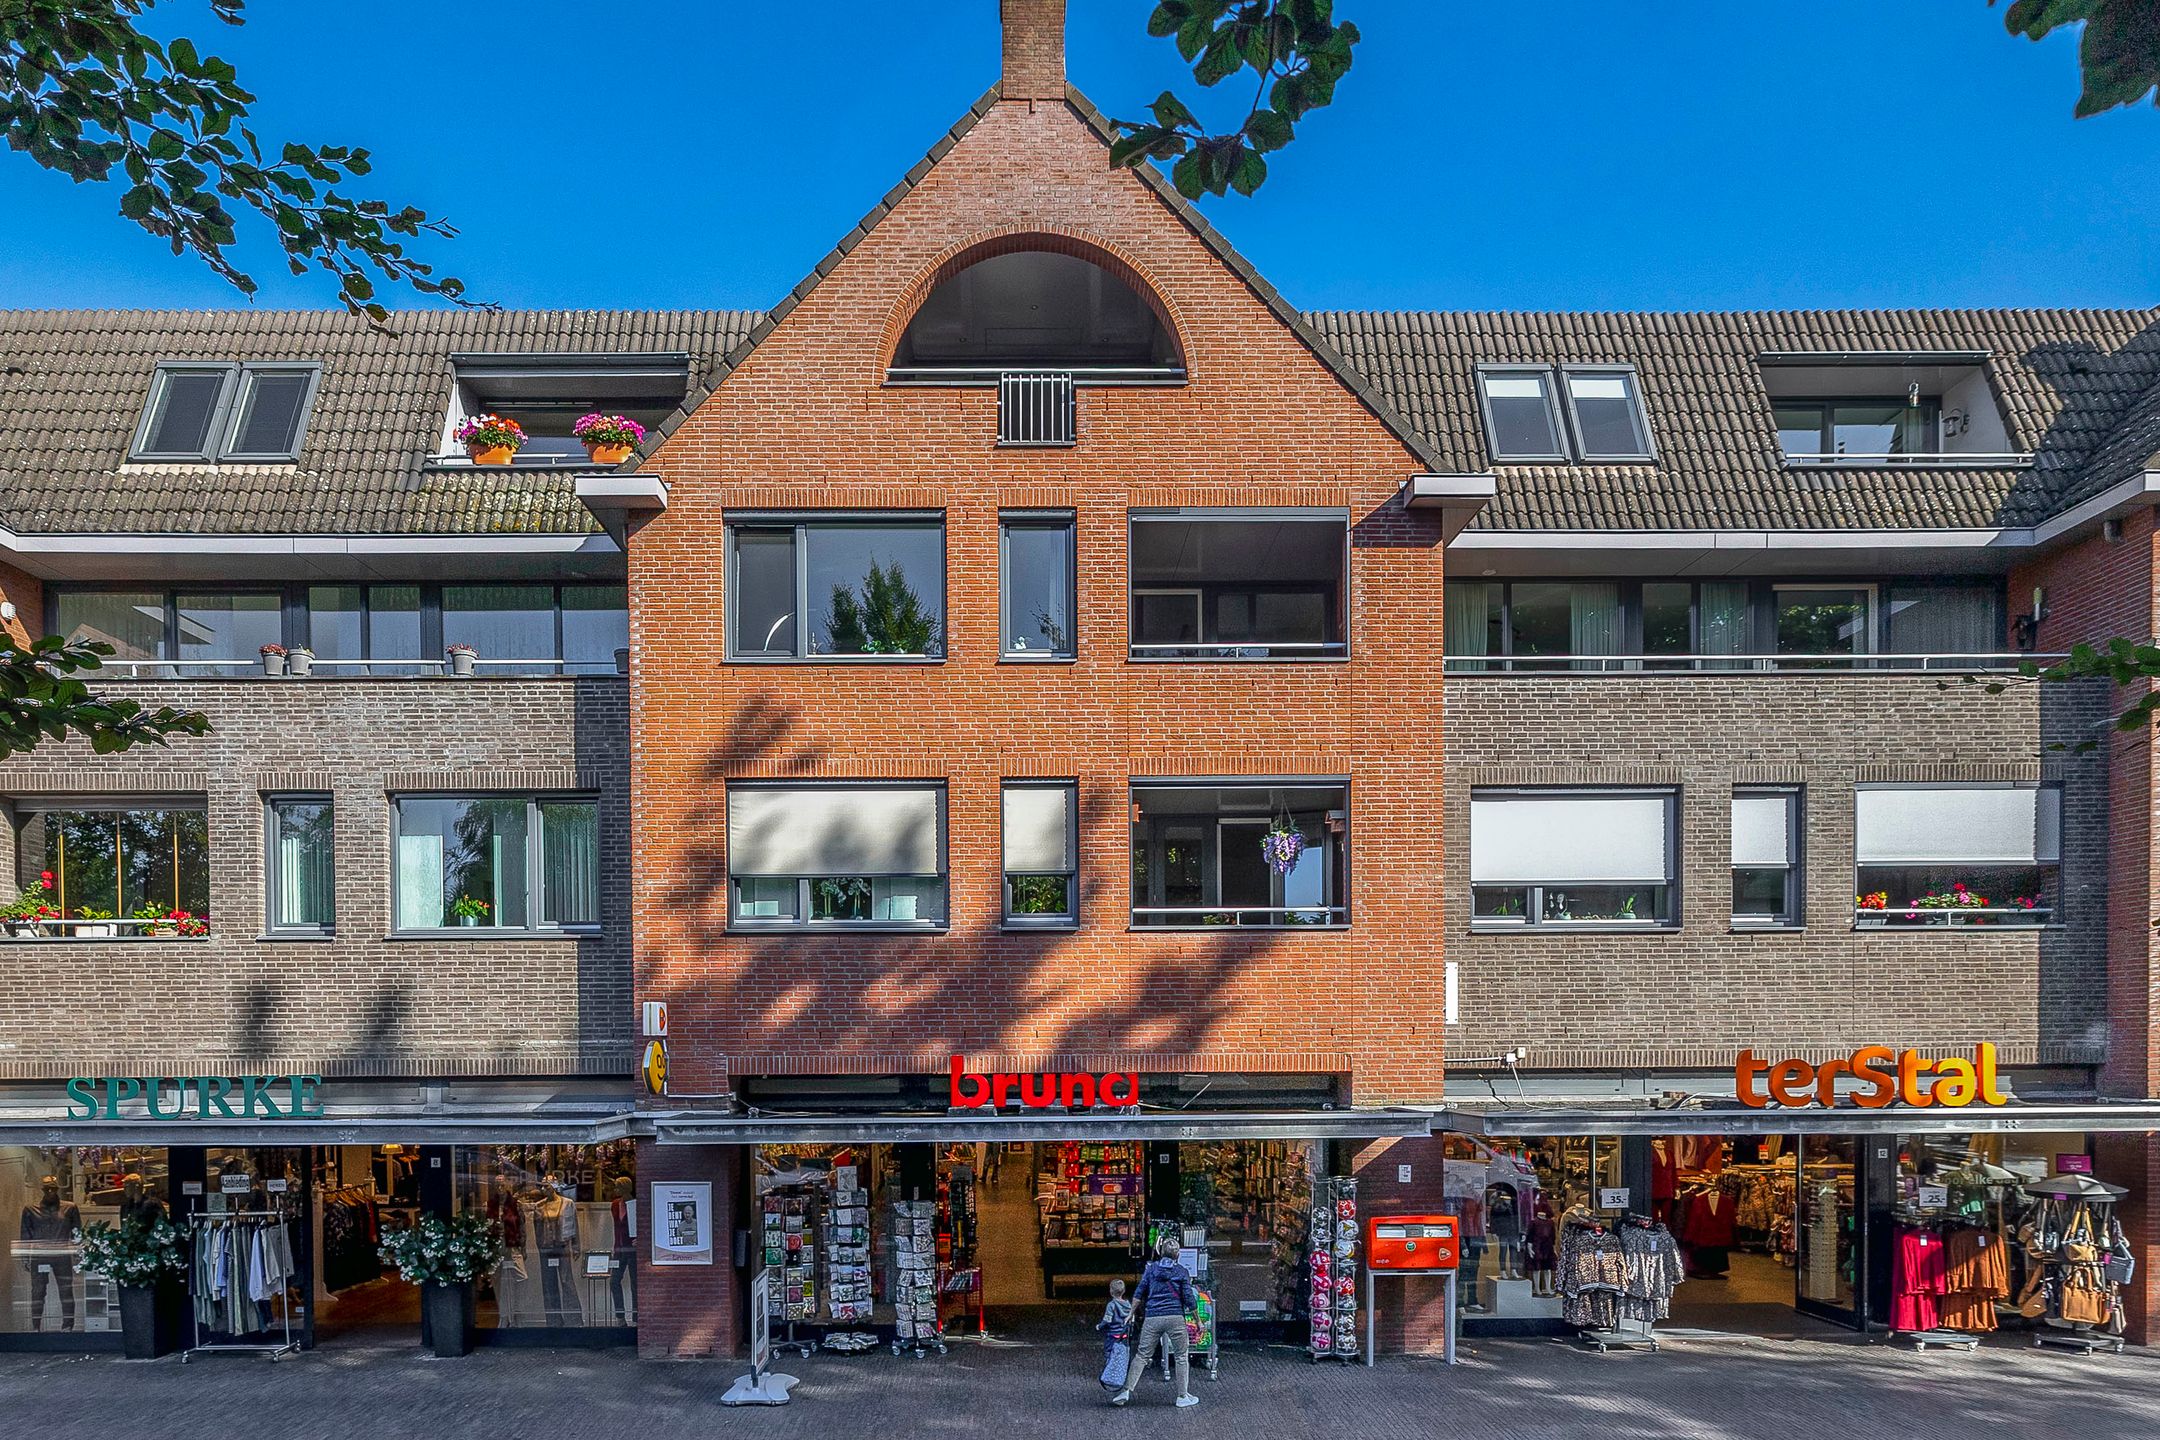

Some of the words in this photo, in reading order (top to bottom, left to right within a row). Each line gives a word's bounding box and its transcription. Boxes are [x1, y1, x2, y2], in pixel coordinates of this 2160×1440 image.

[66, 1075, 325, 1121] SPURKE
[951, 1055, 1139, 1108] bruna
[1736, 1042, 2007, 1108] terStal
